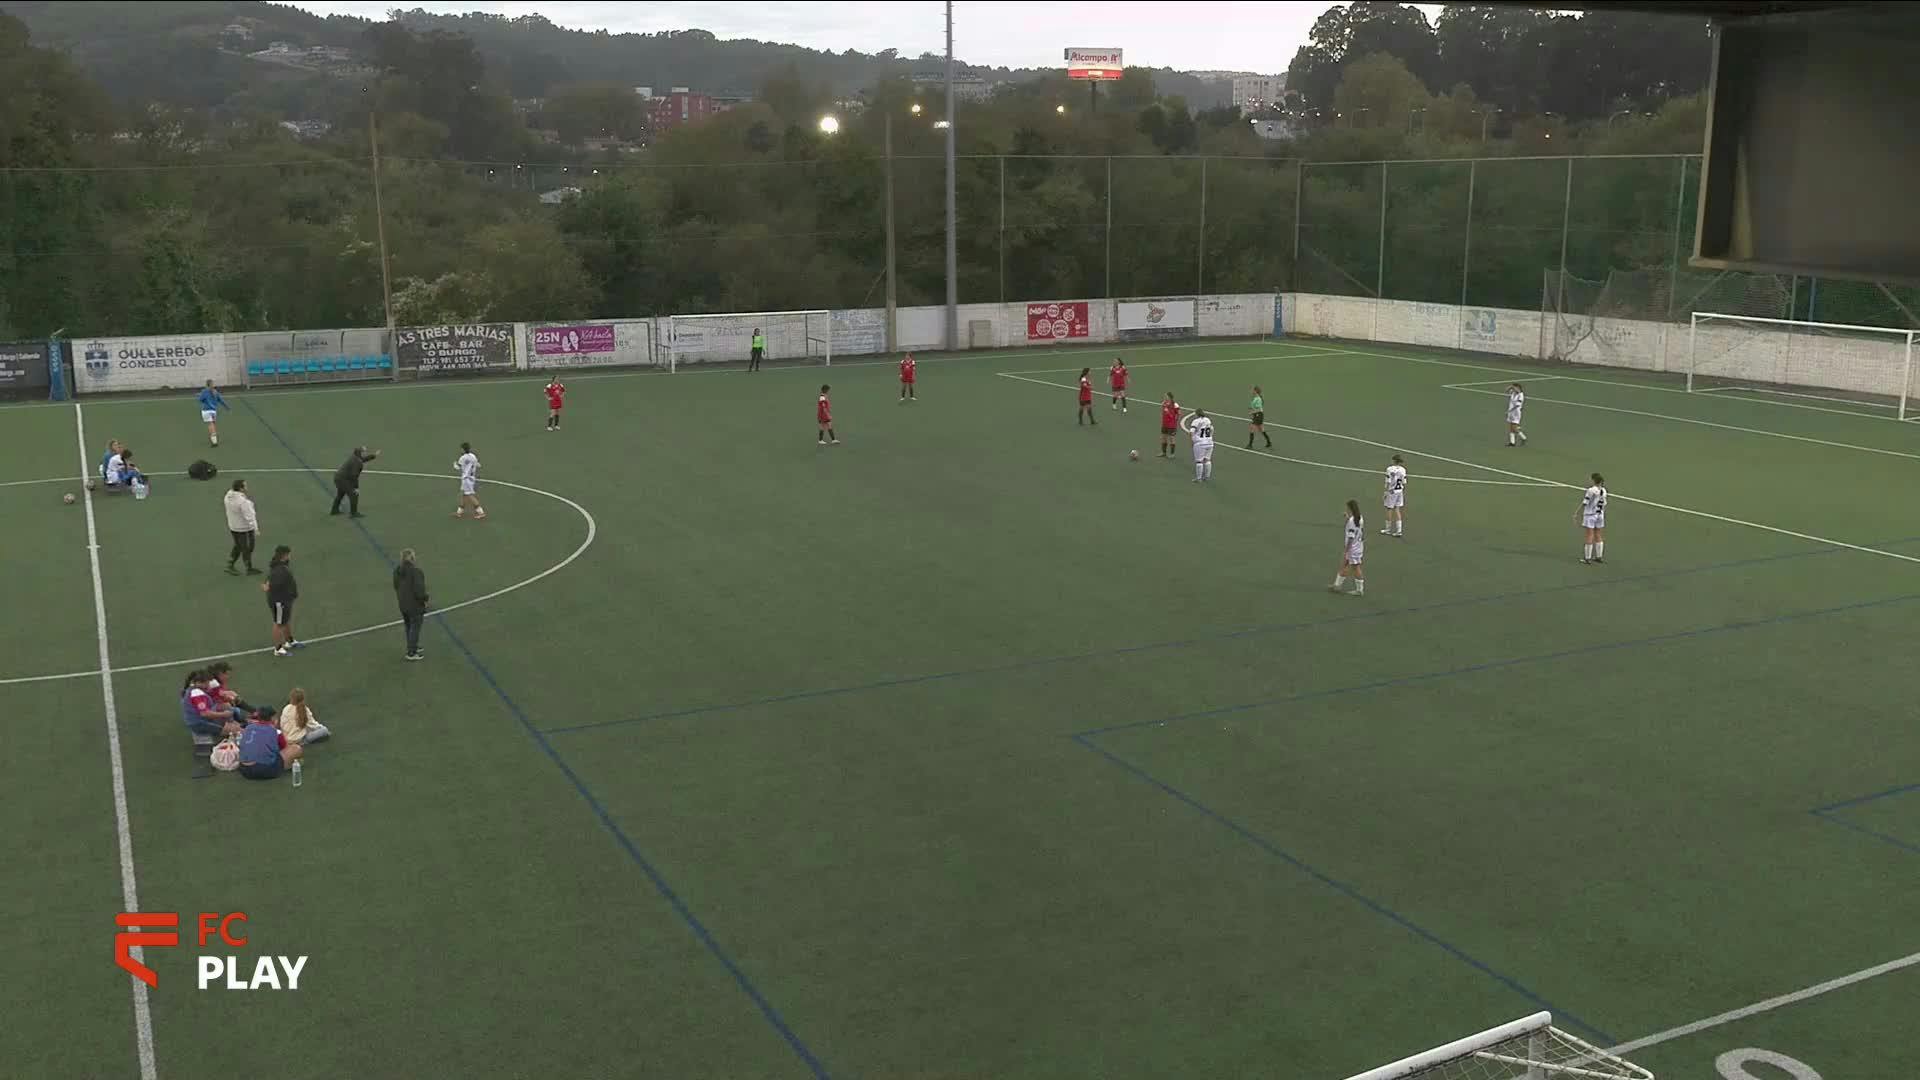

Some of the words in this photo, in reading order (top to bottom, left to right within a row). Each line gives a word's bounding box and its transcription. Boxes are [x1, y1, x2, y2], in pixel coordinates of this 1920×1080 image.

[1070, 52, 1108, 63] Alcampo
[398, 332, 416, 347] AS
[416, 326, 450, 341] TRES
[454, 325, 508, 341] MARIAS
[535, 331, 560, 343] 25N
[459, 340, 484, 349] BAR
[438, 348, 477, 357] BURGO
[119, 358, 188, 369] CONCELLO
